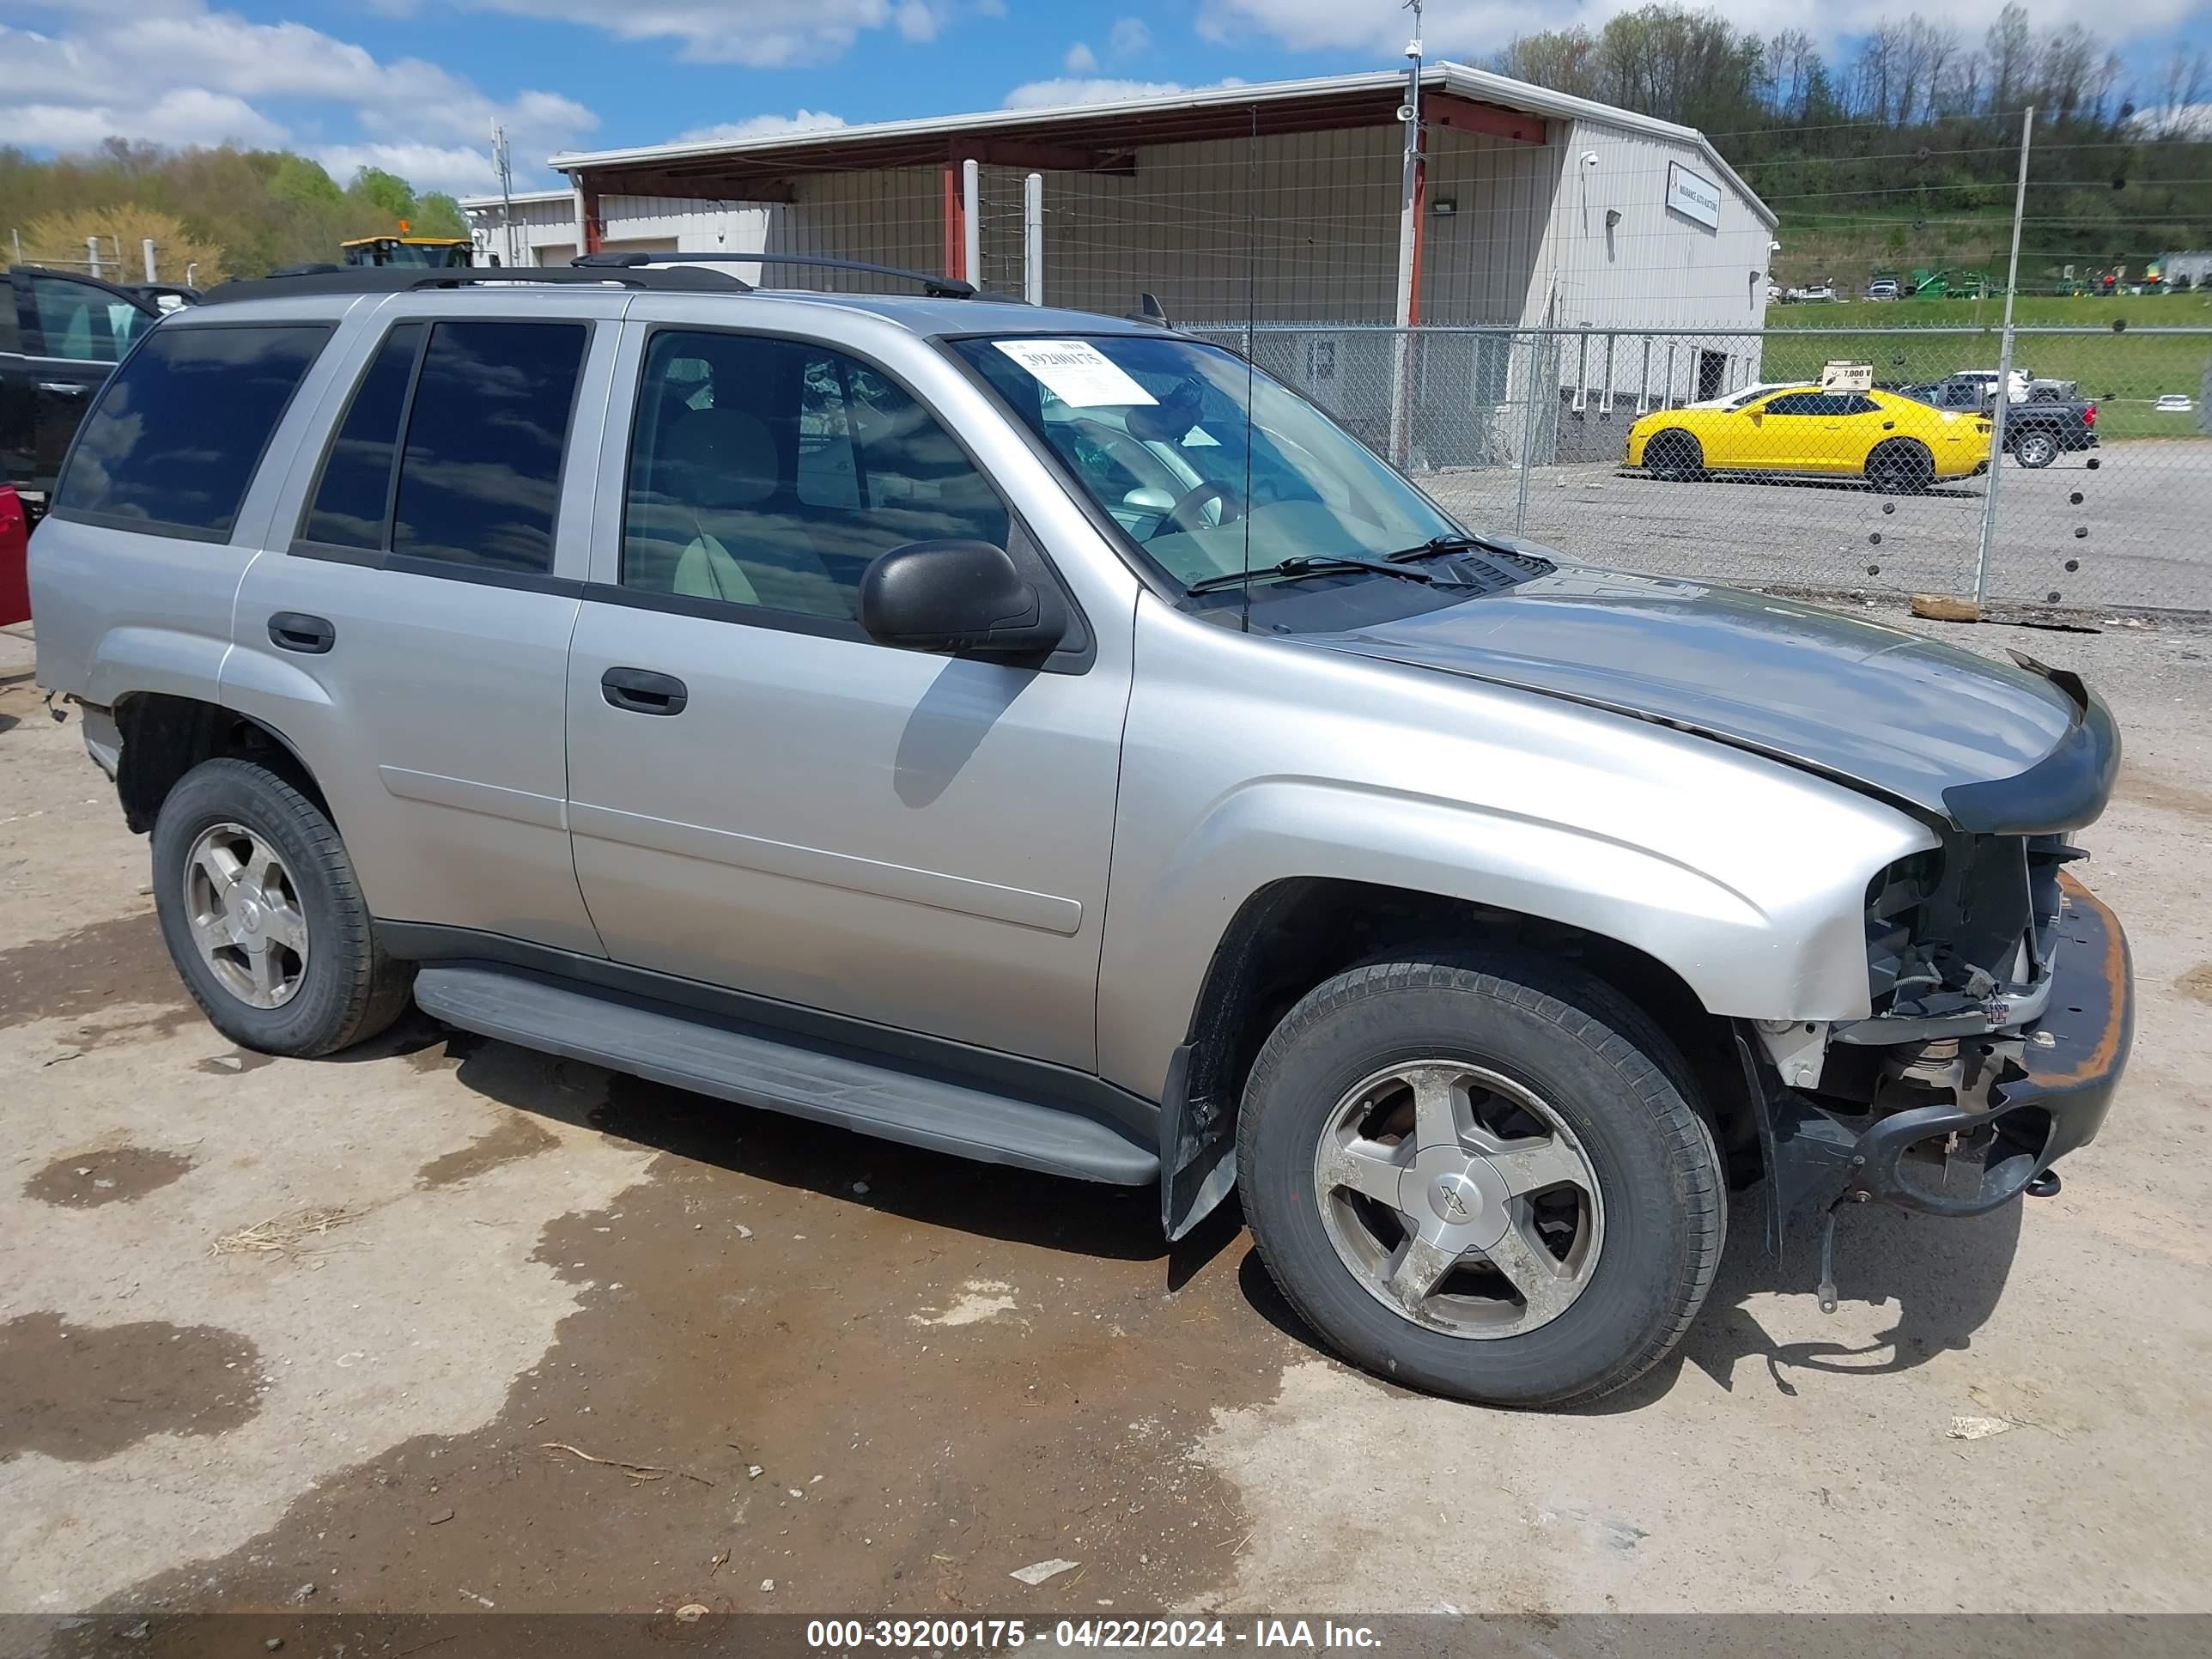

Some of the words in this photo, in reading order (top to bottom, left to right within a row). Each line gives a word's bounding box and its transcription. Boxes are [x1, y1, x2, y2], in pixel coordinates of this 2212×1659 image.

[1680, 185, 1697, 202] INSURANCE
[1022, 353, 1103, 366] 39200175
[1844, 369, 1864, 378] 7,000
